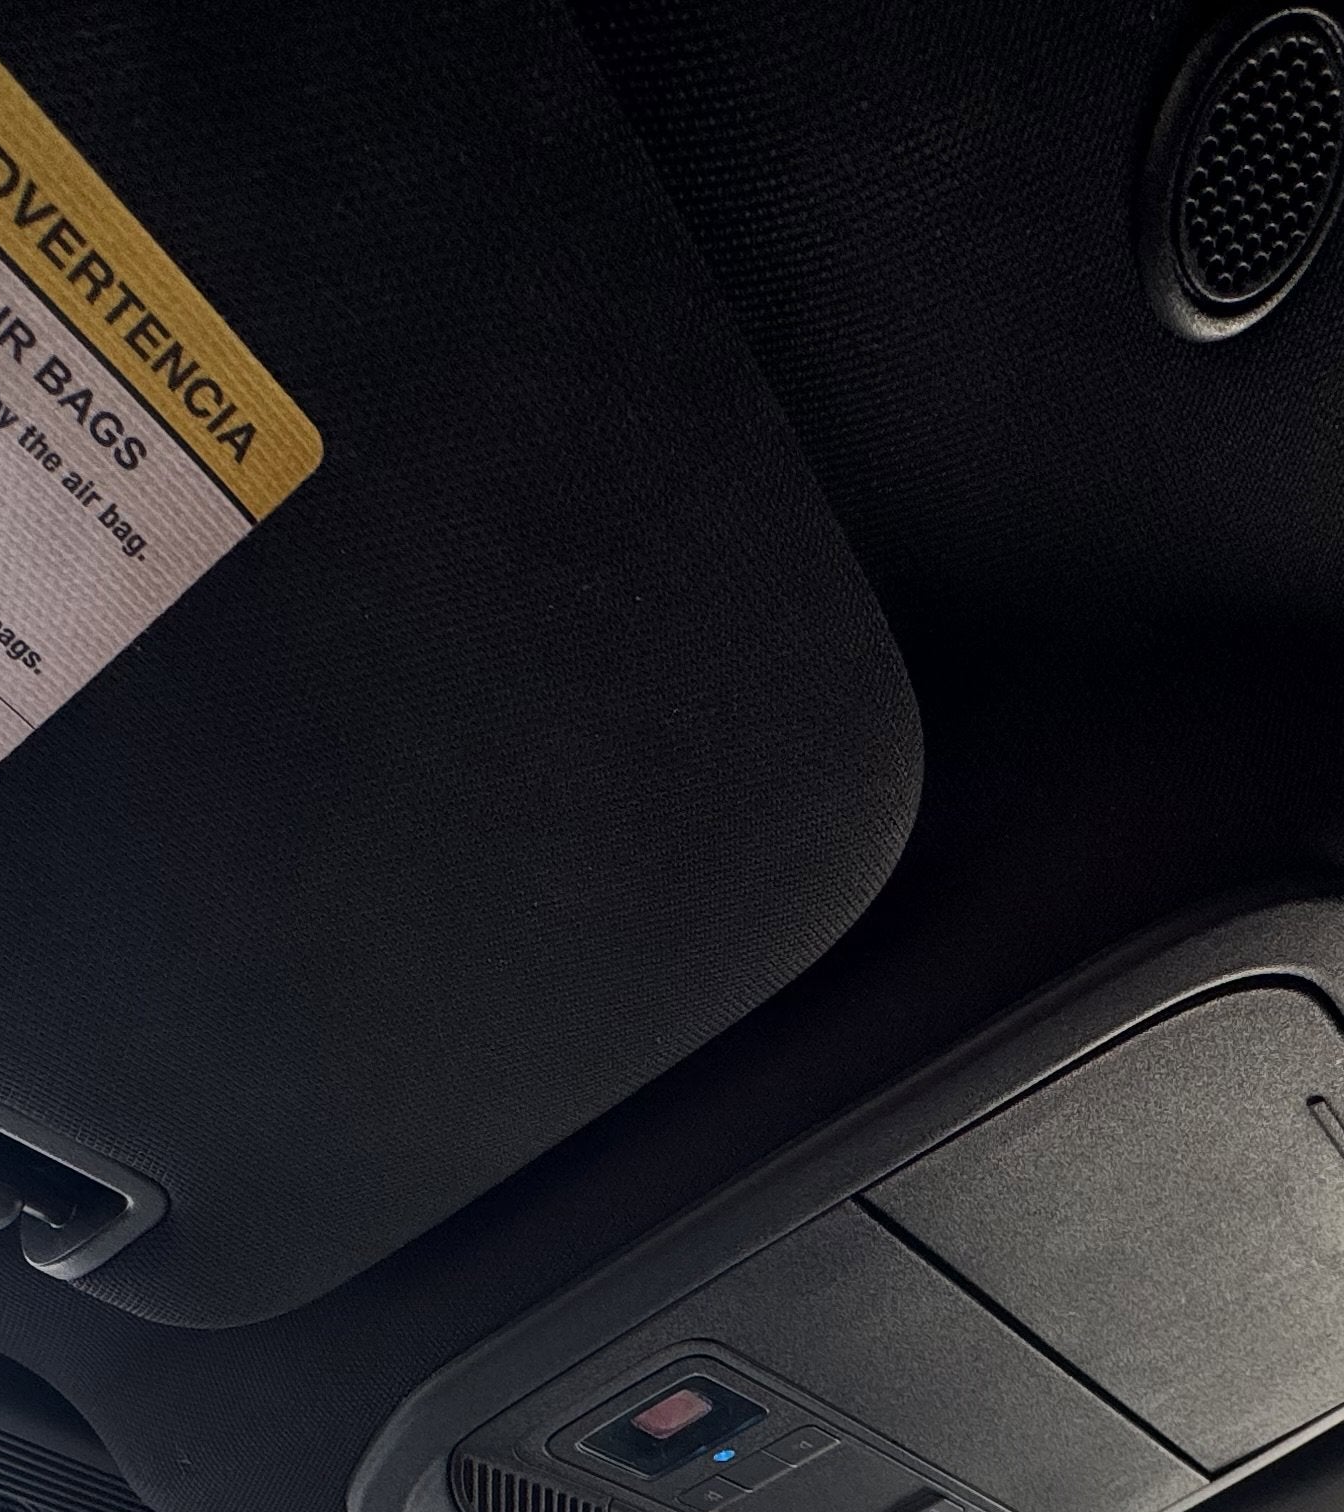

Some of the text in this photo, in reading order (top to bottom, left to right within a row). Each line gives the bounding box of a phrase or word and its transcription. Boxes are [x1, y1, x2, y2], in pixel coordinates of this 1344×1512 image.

[31, 353, 148, 472] BAGS
[16, 423, 63, 473] the
[59, 469, 103, 508] air
[96, 501, 148, 562] bag.
